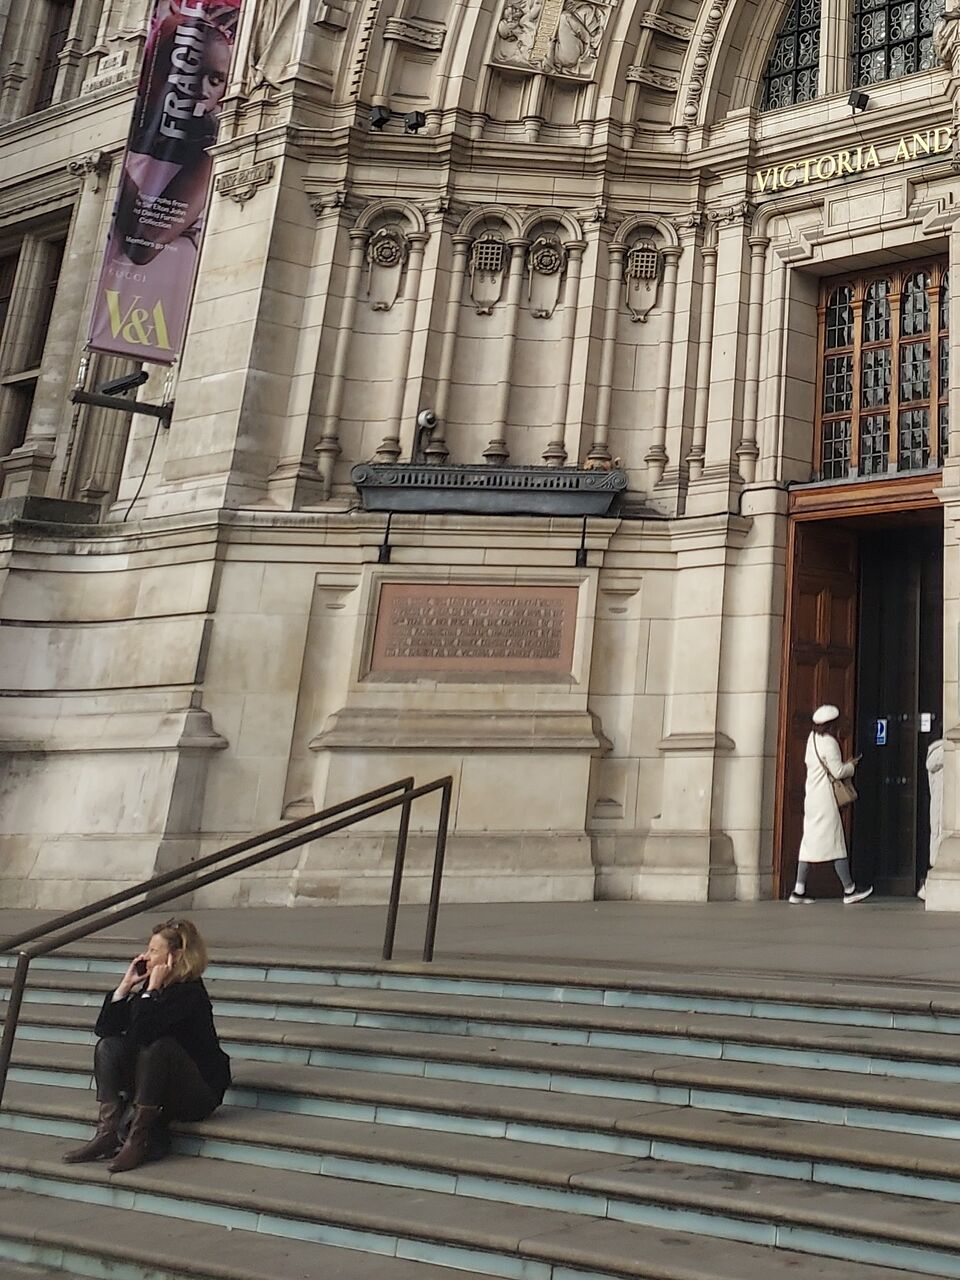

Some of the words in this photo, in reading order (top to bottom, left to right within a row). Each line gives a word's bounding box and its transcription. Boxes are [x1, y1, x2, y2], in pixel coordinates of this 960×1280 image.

[756, 145, 881, 192] VICTORIA
[894, 127, 953, 163] AND
[104, 289, 172, 350] V&A
